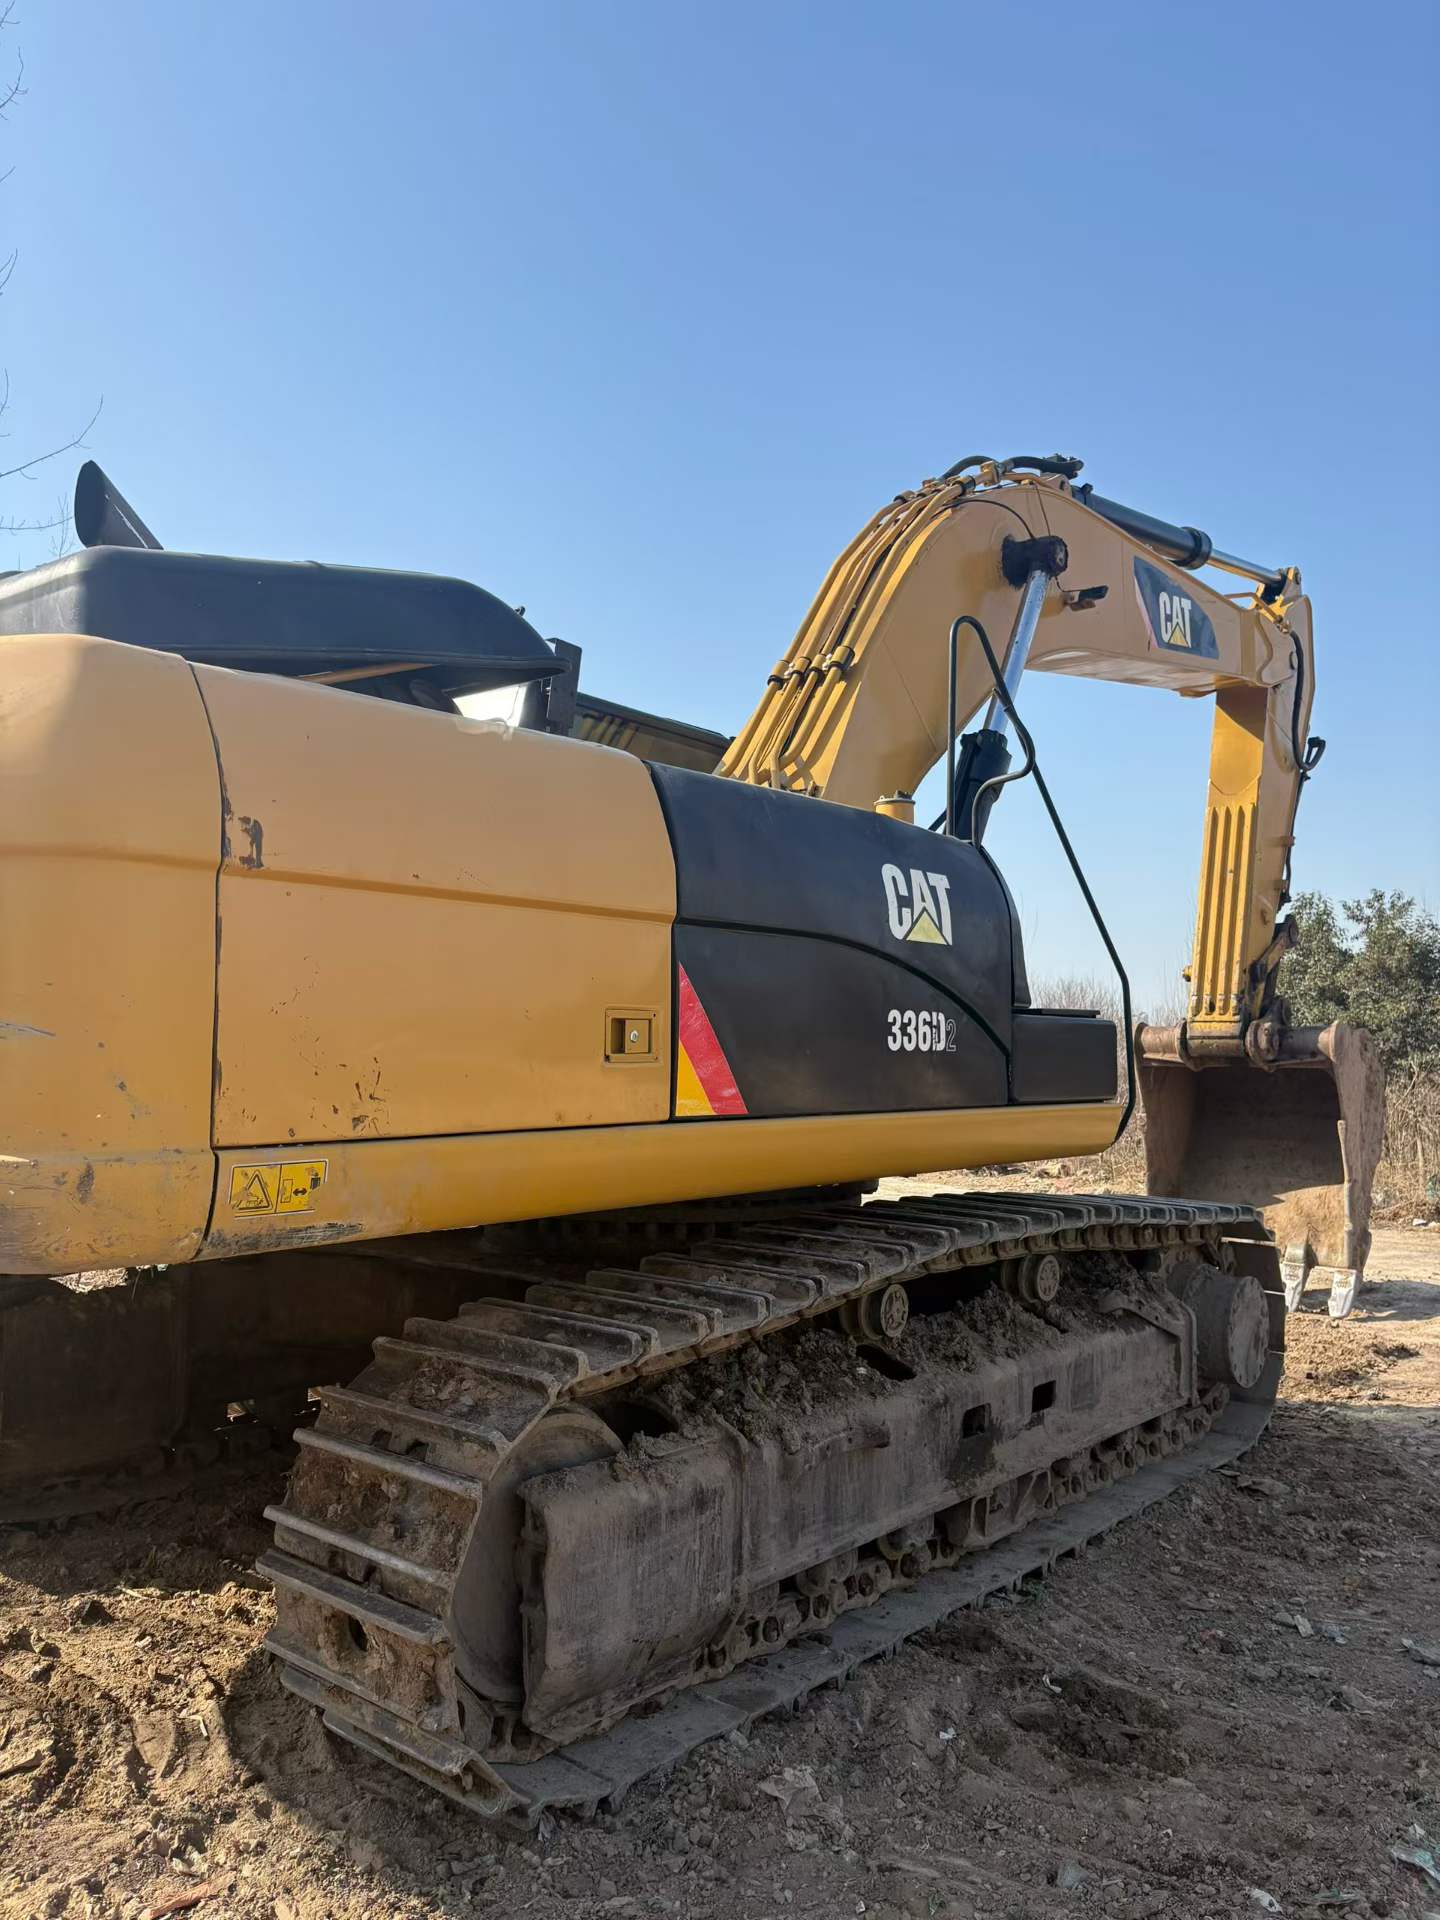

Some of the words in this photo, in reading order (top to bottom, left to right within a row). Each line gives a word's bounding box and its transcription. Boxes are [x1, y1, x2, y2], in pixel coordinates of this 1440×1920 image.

[1159, 592, 1192, 648] CAT
[881, 863, 953, 945] CAT
[887, 1009, 957, 1052] 336D2
